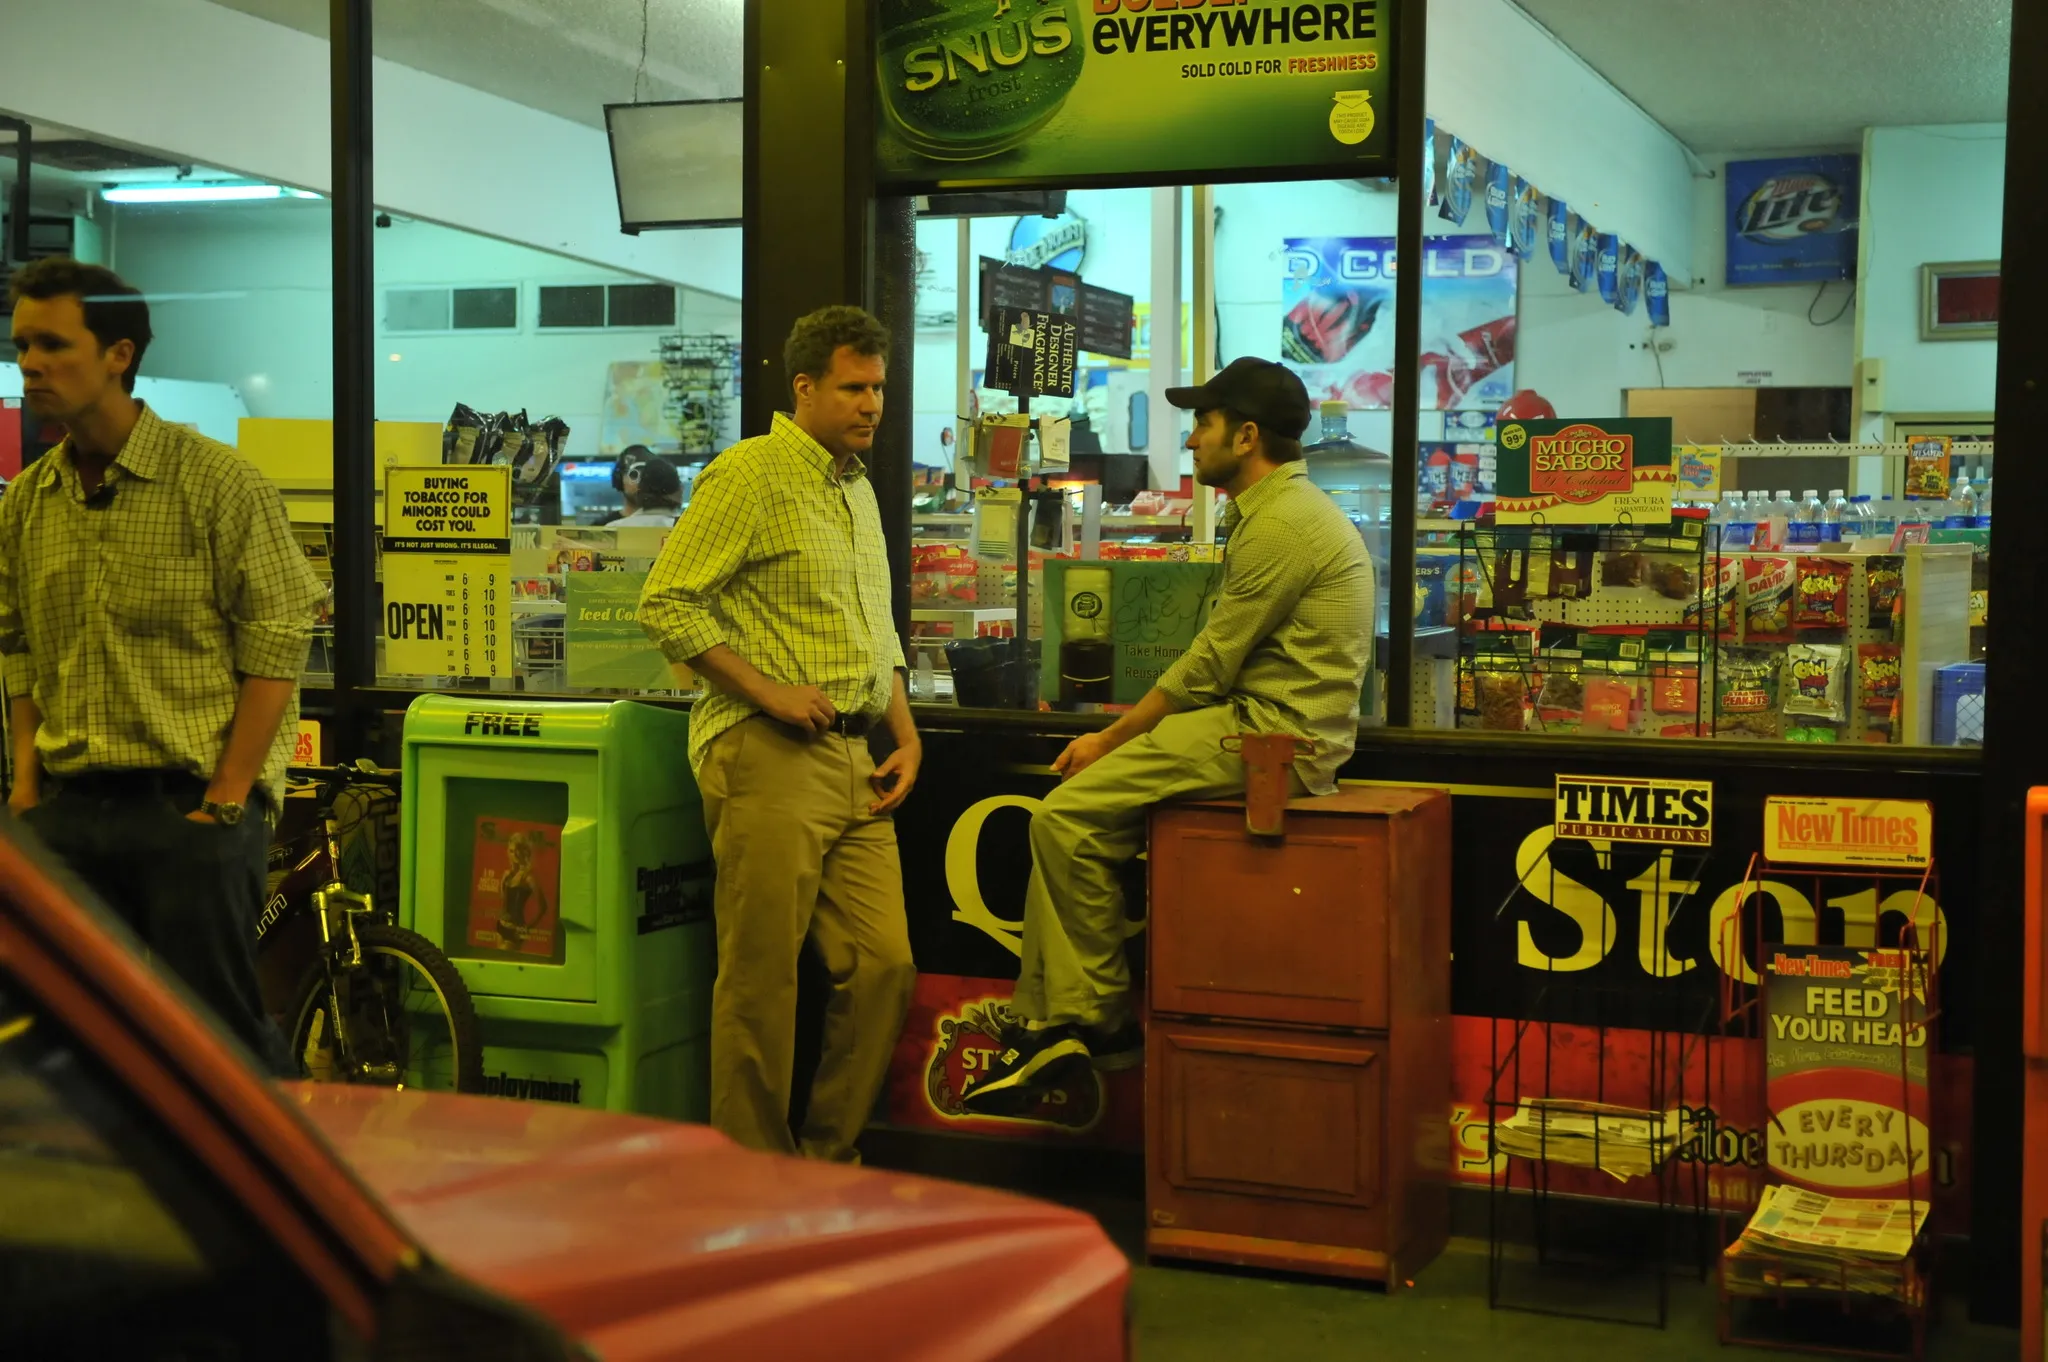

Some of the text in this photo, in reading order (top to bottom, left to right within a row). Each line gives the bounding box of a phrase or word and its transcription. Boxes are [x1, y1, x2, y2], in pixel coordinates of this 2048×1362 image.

[903, 6, 1073, 92] SNUS
[1181, 54, 1377, 78] SOLD COLD FOR FRESHNESS
[967, 76, 1022, 102] frost
[1741, 188, 1845, 235] Lite
[1047, 325, 1062, 387] DESIGNER
[1061, 321, 1076, 393] AUTHENTIC
[1536, 439, 1626, 455] MUCHO
[1535, 455, 1625, 471] SABOR
[424, 477, 469, 490] BUYING
[404, 491, 488, 503] TOBACCO FOR
[1614, 497, 1665, 506] FRESCURA
[402, 505, 491, 518] MINORS COULD
[415, 519, 476, 532] COST YOU.
[406, 541, 419, 549] NOT
[462, 573, 468, 585] 6
[489, 573, 495, 586] 9
[1749, 570, 1786, 594] DAVID
[462, 588, 468, 600] 6
[484, 589, 495, 601] 10
[463, 603, 468, 615] 6
[484, 604, 495, 616] 10
[579, 608, 612, 621] Iced
[387, 602, 443, 640] OPEN
[463, 618, 468, 630] 6
[484, 619, 495, 631] 10
[464, 633, 469, 645] 6
[484, 634, 496, 646] 10
[464, 649, 469, 660] 6
[485, 649, 495, 661] 10
[1124, 645, 1186, 658] Take Home
[464, 663, 470, 675] 6
[491, 664, 496, 676] 9
[1721, 694, 1770, 707] PEANUTS
[464, 712, 543, 737] FREE
[1559, 783, 1710, 828] TIMES
[1560, 824, 1708, 842] PUBLICATIONS
[1777, 805, 1919, 846] New Times
[1906, 854, 1926, 863] free
[1774, 953, 1805, 976] New
[1806, 954, 1851, 978] Times
[1807, 986, 1888, 1018] FEED
[1771, 1014, 1927, 1048] YOUR HEAD
[483, 1072, 581, 1104] ployment
[1800, 1104, 1894, 1136] EVERY
[1775, 1141, 1923, 1174] THURSDAY
